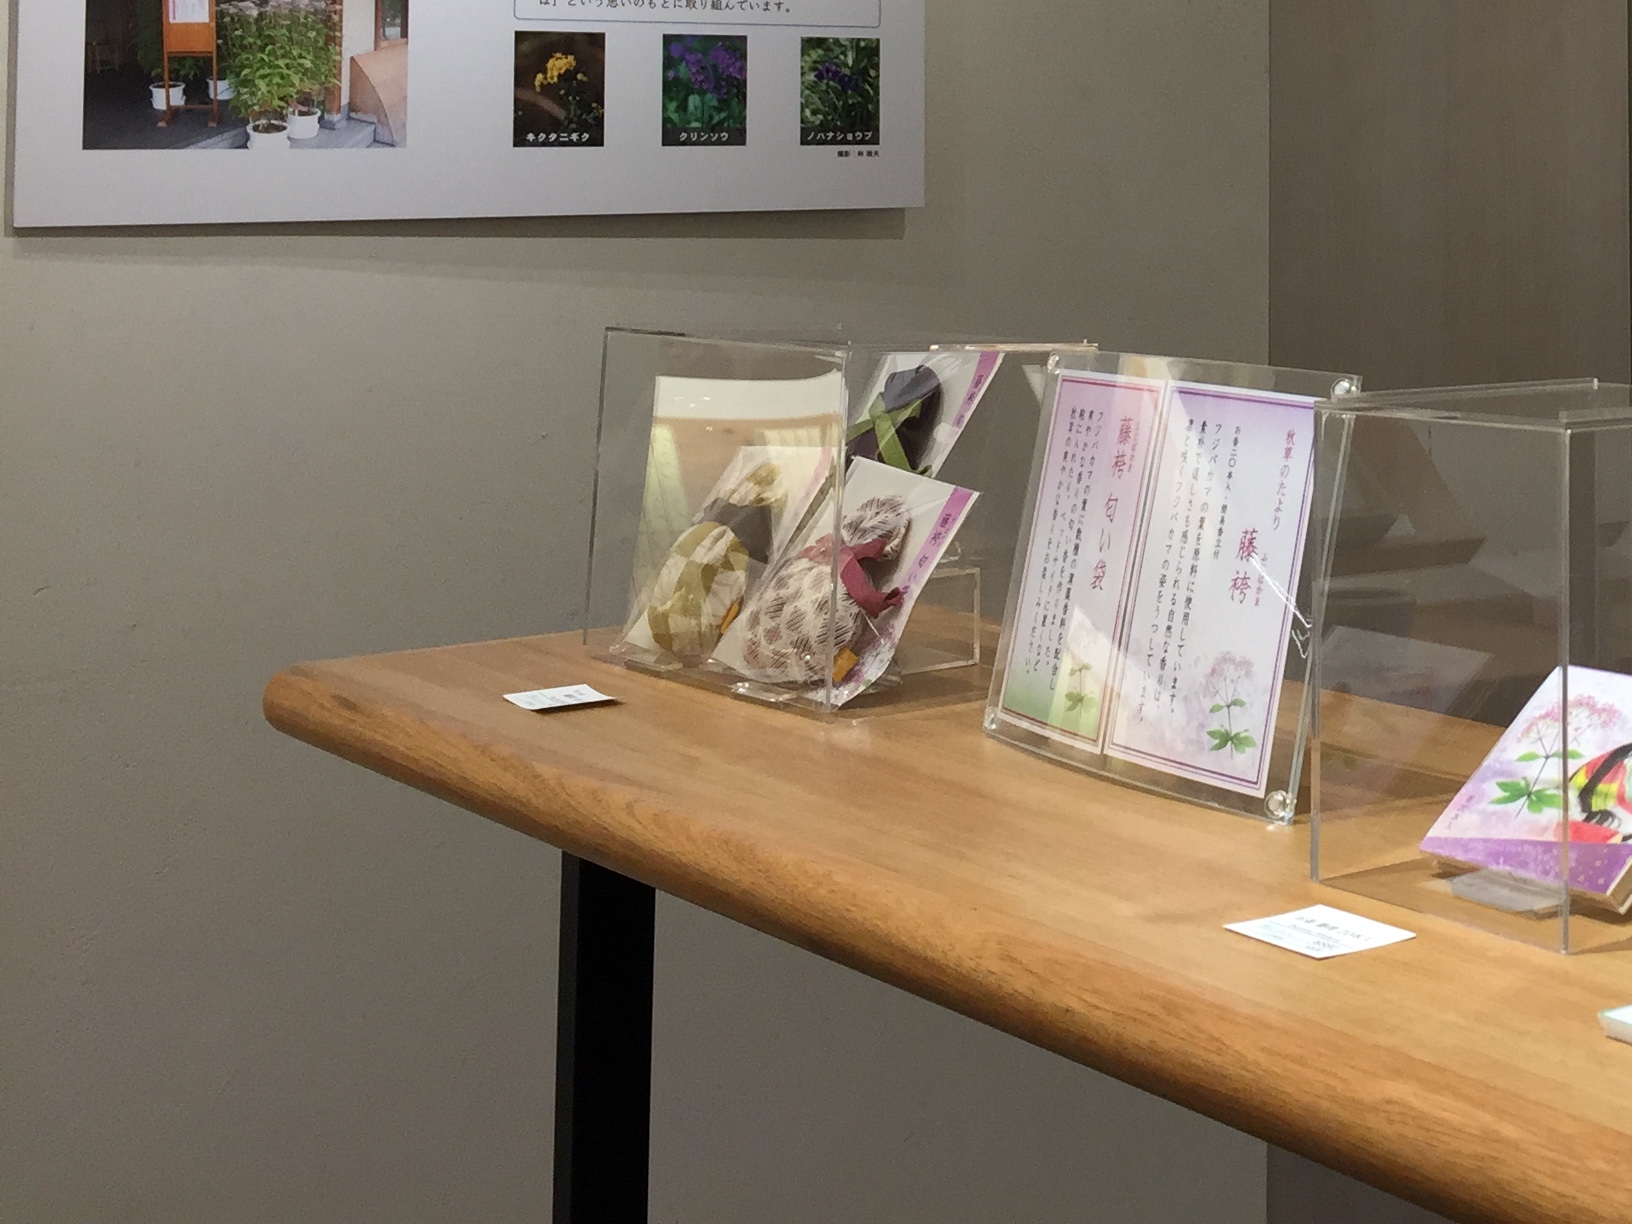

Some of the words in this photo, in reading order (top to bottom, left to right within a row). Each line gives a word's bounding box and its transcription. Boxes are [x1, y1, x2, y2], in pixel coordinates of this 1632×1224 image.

[679, 130, 729, 141] クリンソウ
[1112, 416, 1134, 479] 藤袴
[1273, 429, 1295, 531] 秋草のたより
[1090, 493, 1119, 590] 匂い袋
[1229, 528, 1259, 604] 藤袴
